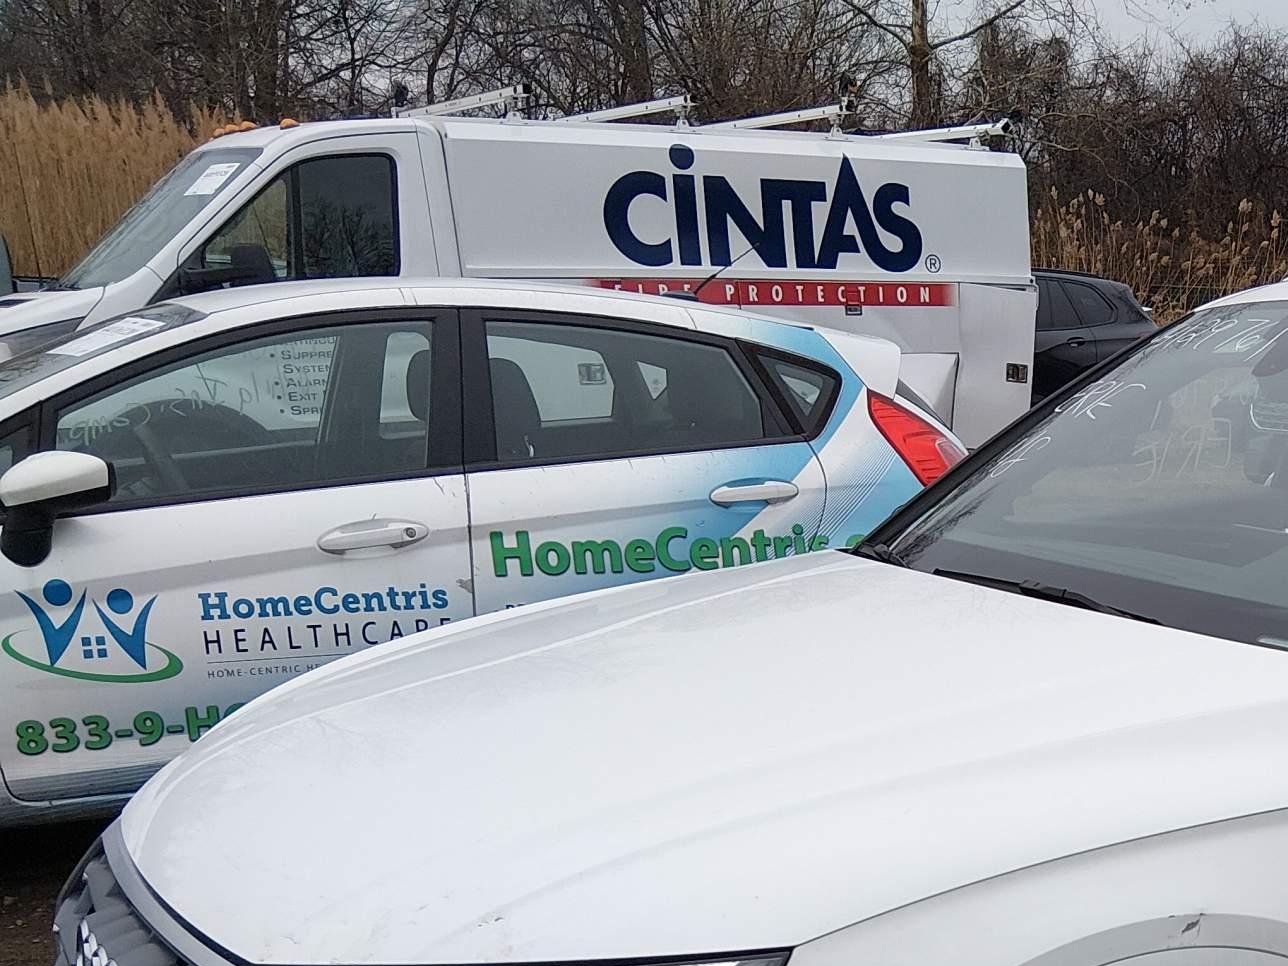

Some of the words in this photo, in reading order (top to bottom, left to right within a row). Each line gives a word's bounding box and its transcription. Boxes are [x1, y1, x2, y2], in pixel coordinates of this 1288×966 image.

[603, 143, 923, 272] CINTAS
[725, 284, 929, 303] PROTECTION
[198, 583, 449, 622] HomeCentris
[207, 664, 300, 679] HOME-CENTRIC
